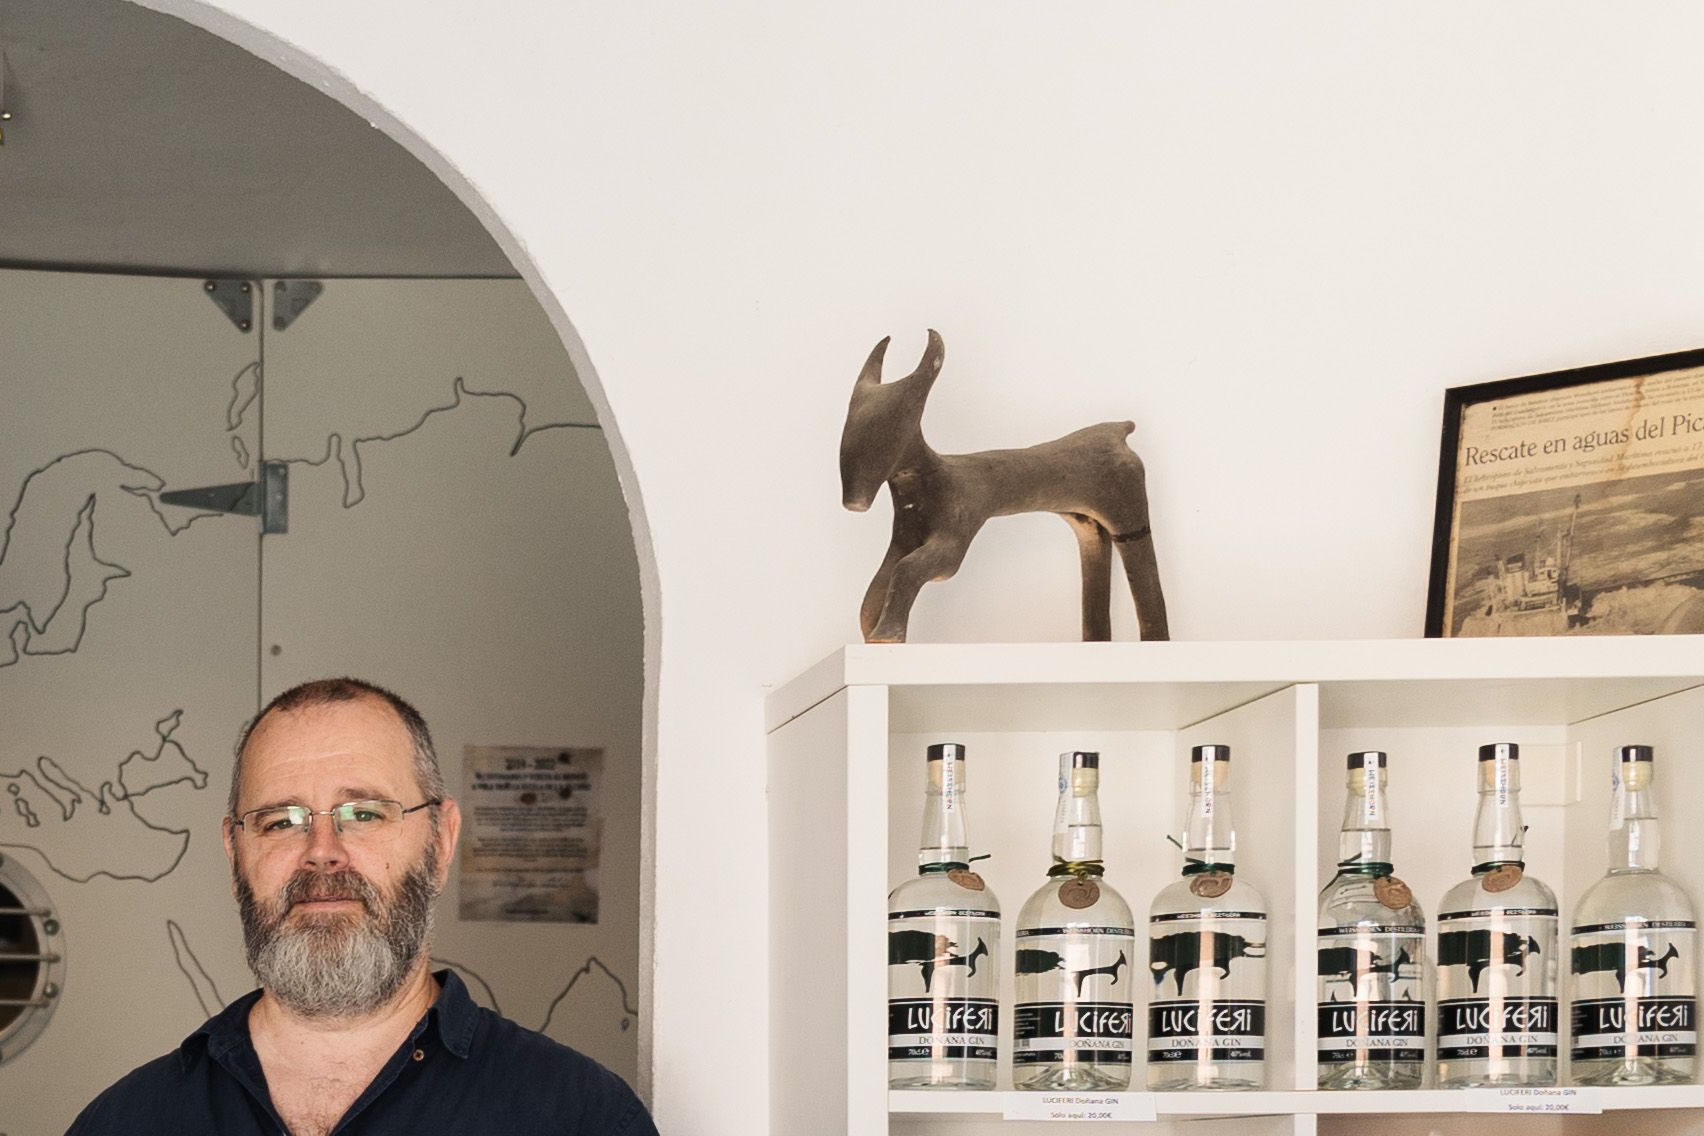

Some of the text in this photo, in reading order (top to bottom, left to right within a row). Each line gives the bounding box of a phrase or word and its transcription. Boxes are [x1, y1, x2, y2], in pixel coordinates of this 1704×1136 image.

[1464, 440, 1537, 466] Rescate
[1543, 437, 1566, 455] en
[1572, 428, 1630, 451] aguas
[1635, 416, 1664, 440] del
[967, 1035, 985, 1045] GIN
[1222, 1038, 1241, 1047] GIN
[1042, 1096, 1119, 1105] LUCIFERI Doñana GIN
[1508, 1103, 1524, 1111] Solo
[1545, 1103, 1569, 1112] 20,00€
[1050, 1111, 1065, 1119] Solo
[1087, 1111, 1112, 1120] 20,00€
